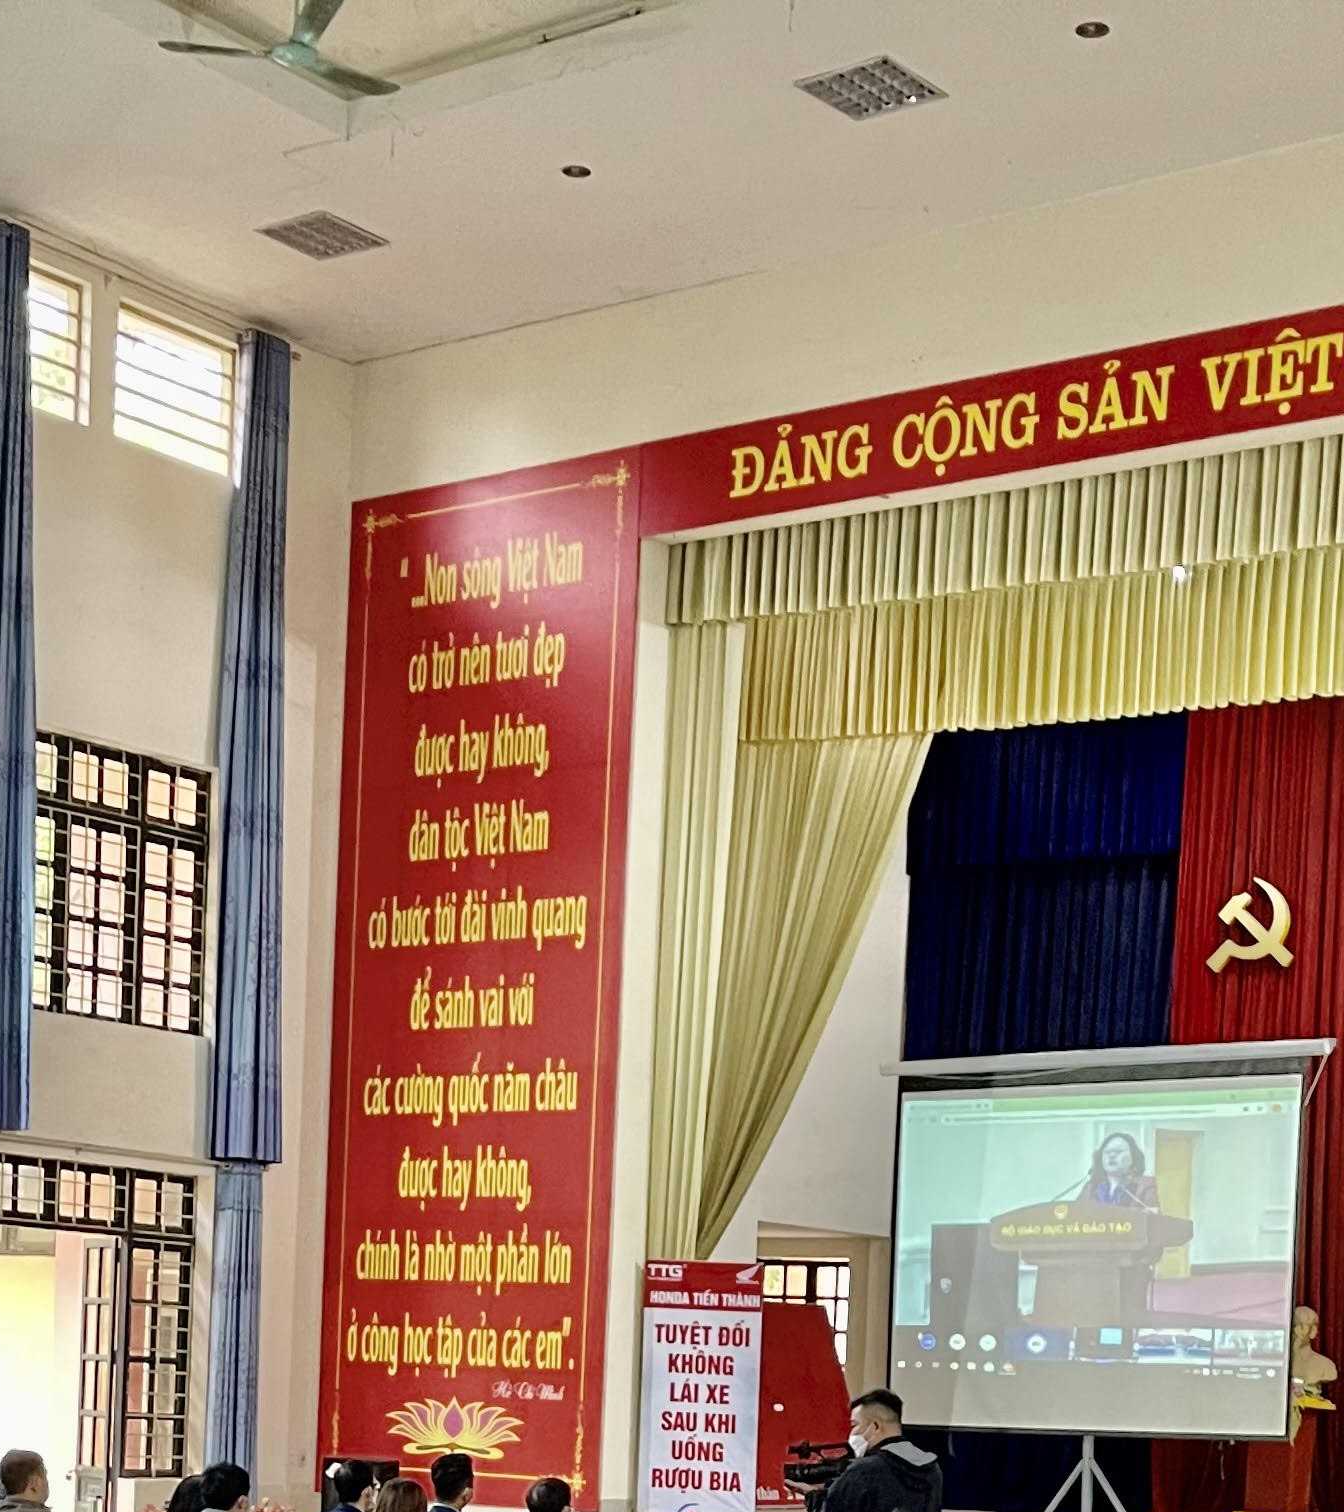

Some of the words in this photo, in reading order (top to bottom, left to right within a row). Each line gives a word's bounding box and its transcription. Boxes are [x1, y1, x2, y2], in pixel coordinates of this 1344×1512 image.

[729, 423, 873, 499] ĐẢNG
[892, 395, 1040, 477] CỘNG
[1057, 359, 1176, 440] SẢN
[1200, 327, 1344, 415] VIỆT
[461, 546, 502, 609] sông
[508, 536, 539, 605] Việt
[542, 531, 583, 588] Nam
[408, 639, 427, 694] có
[432, 631, 456, 691] trở
[459, 631, 491, 686] nên
[496, 623, 529, 681] tươi
[533, 620, 566, 688] đẹp
[414, 723, 455, 789] được
[458, 718, 489, 784] hay
[493, 712, 549, 778] không,
[409, 808, 439, 862] dân
[444, 806, 469, 872] tộc
[474, 801, 506, 869] Việt
[509, 798, 549, 853] Nam
[368, 897, 387, 949] có
[391, 894, 431, 948] bước
[435, 891, 457, 945] tới
[460, 889, 487, 943] đài
[491, 885, 528, 941] vinh
[532, 895, 588, 951] quang
[410, 966, 432, 1031] để
[434, 975, 475, 1029] sánh
[479, 974, 505, 1027] vai
[508, 972, 535, 1026] với
[363, 1064, 391, 1115] các
[394, 1063, 444, 1127] cường
[448, 1051, 489, 1126] quốc
[493, 1061, 531, 1112] năm
[535, 1057, 578, 1111] châu
[398, 1145, 438, 1212] được
[441, 1145, 472, 1211] hay
[475, 1144, 532, 1212] không,
[356, 1228, 400, 1280] chính
[404, 1229, 420, 1281] là
[424, 1229, 456, 1281] nhờ
[459, 1230, 493, 1296] một
[543, 1229, 572, 1284] lớn
[647, 1263, 683, 1277] TTG
[649, 1290, 690, 1305] HONDA
[347, 1308, 358, 1362] ở
[361, 1312, 399, 1377] công
[403, 1312, 433, 1377] học
[436, 1313, 463, 1378] tập
[467, 1311, 498, 1367] của
[501, 1315, 531, 1368] các
[655, 1320, 712, 1349] TUYỆT
[718, 1319, 750, 1347] ĐỐI
[668, 1350, 734, 1376] KHÔNG
[661, 1410, 698, 1432] SAU
[704, 1412, 736, 1434] KHI
[669, 1378, 699, 1403] LÁI
[705, 1383, 730, 1405] XE
[651, 1467, 703, 1493] RƯỢU
[709, 1471, 741, 1492] BIA
[671, 1434, 724, 1462] UỐNG
